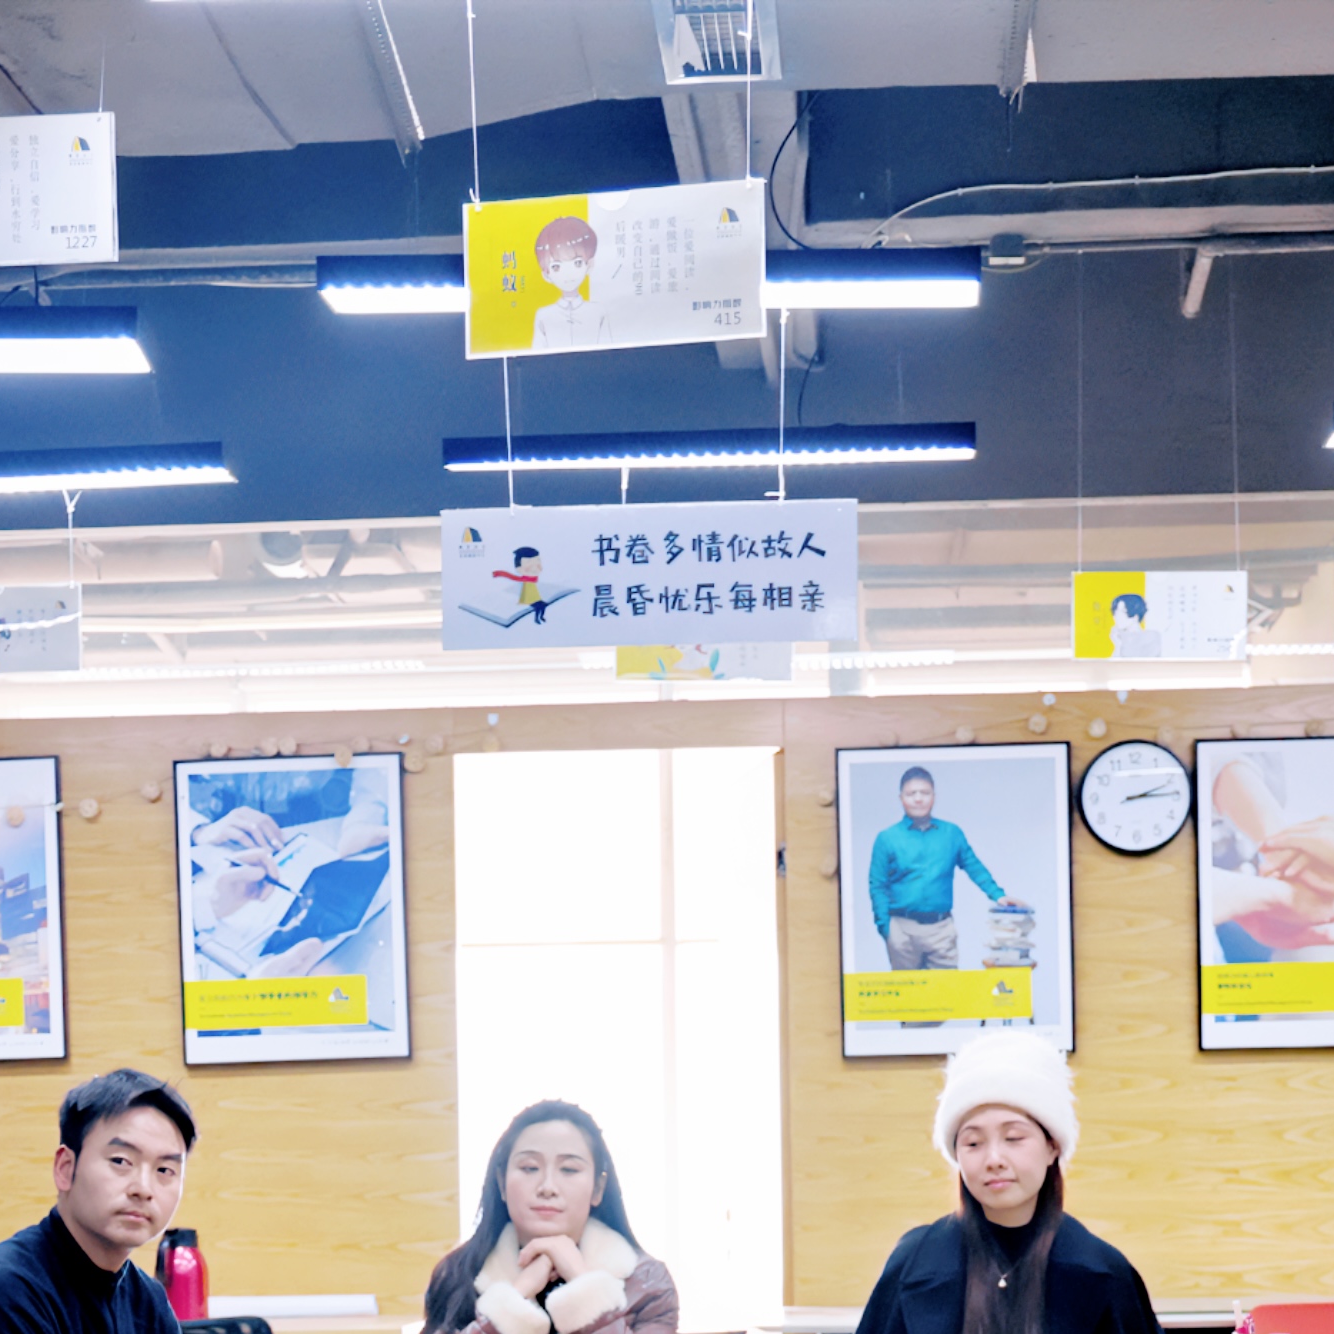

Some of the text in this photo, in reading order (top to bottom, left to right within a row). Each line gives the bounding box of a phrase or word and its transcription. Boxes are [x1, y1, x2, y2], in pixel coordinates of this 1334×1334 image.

[65, 235, 98, 250] 1227
[713, 311, 742, 326] 415
[592, 530, 827, 567] 书卷多情似故人
[592, 578, 826, 618] 晨昏忧乐每相亲
[1128, 751, 1142, 764] 12
[1109, 759, 1121, 771] 11
[1097, 773, 1110, 787] 10
[1089, 791, 1099, 805] 9
[1096, 811, 1106, 825] 8
[1166, 809, 1175, 821] 4
[1114, 825, 1122, 837] 7
[1132, 829, 1142, 844] 6
[1153, 823, 1162, 837] 5
